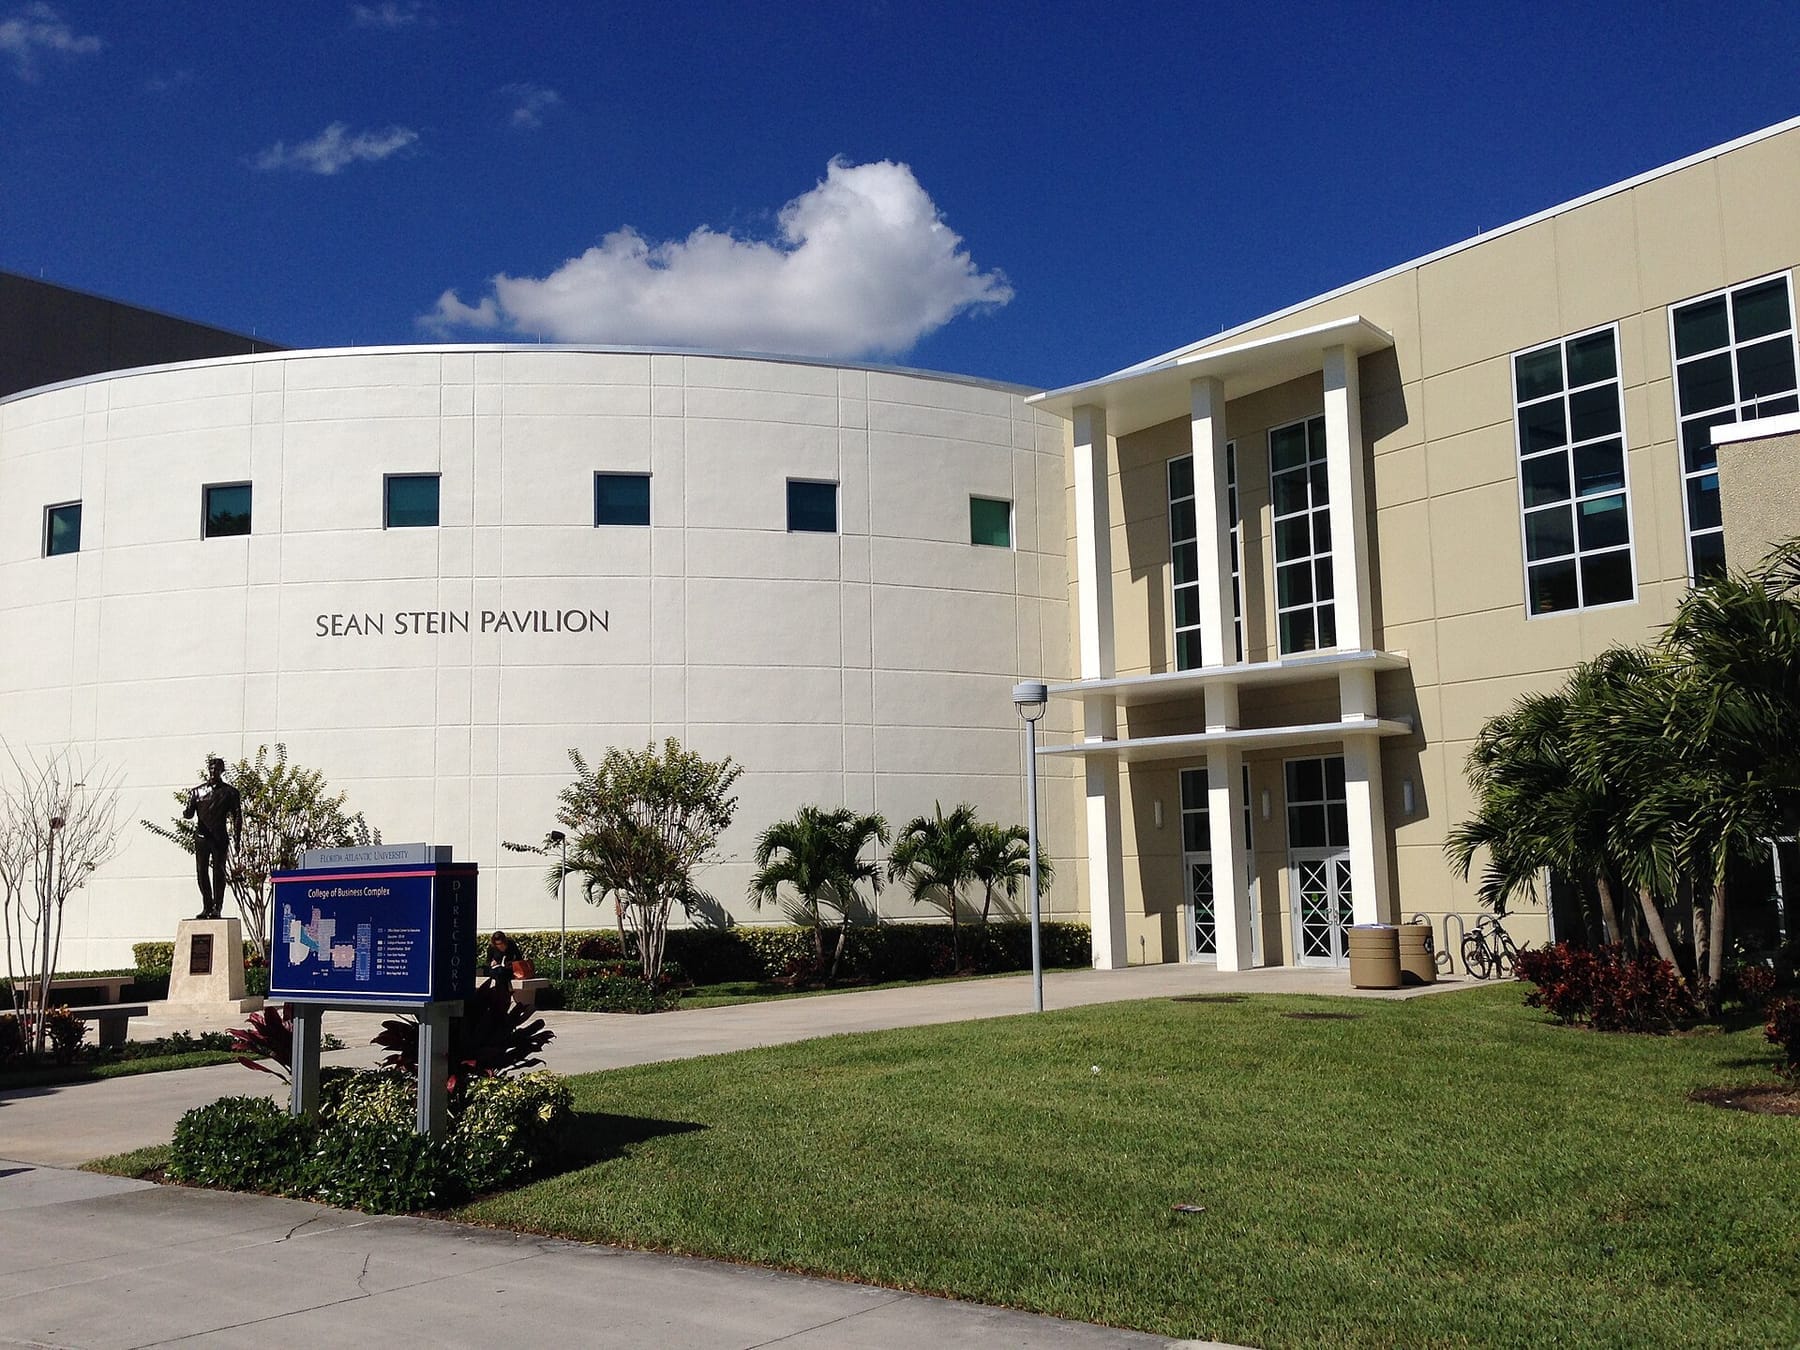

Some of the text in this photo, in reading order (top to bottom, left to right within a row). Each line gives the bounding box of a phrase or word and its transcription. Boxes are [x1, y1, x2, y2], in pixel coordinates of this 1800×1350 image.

[315, 609, 610, 637] SEAN STEIN PAVILION
[320, 850, 409, 863] FLORIDA ATLANTIC UNIVERSITY
[307, 886, 390, 900] College of Business Complex
[451, 880, 461, 992] DIRECTORY
